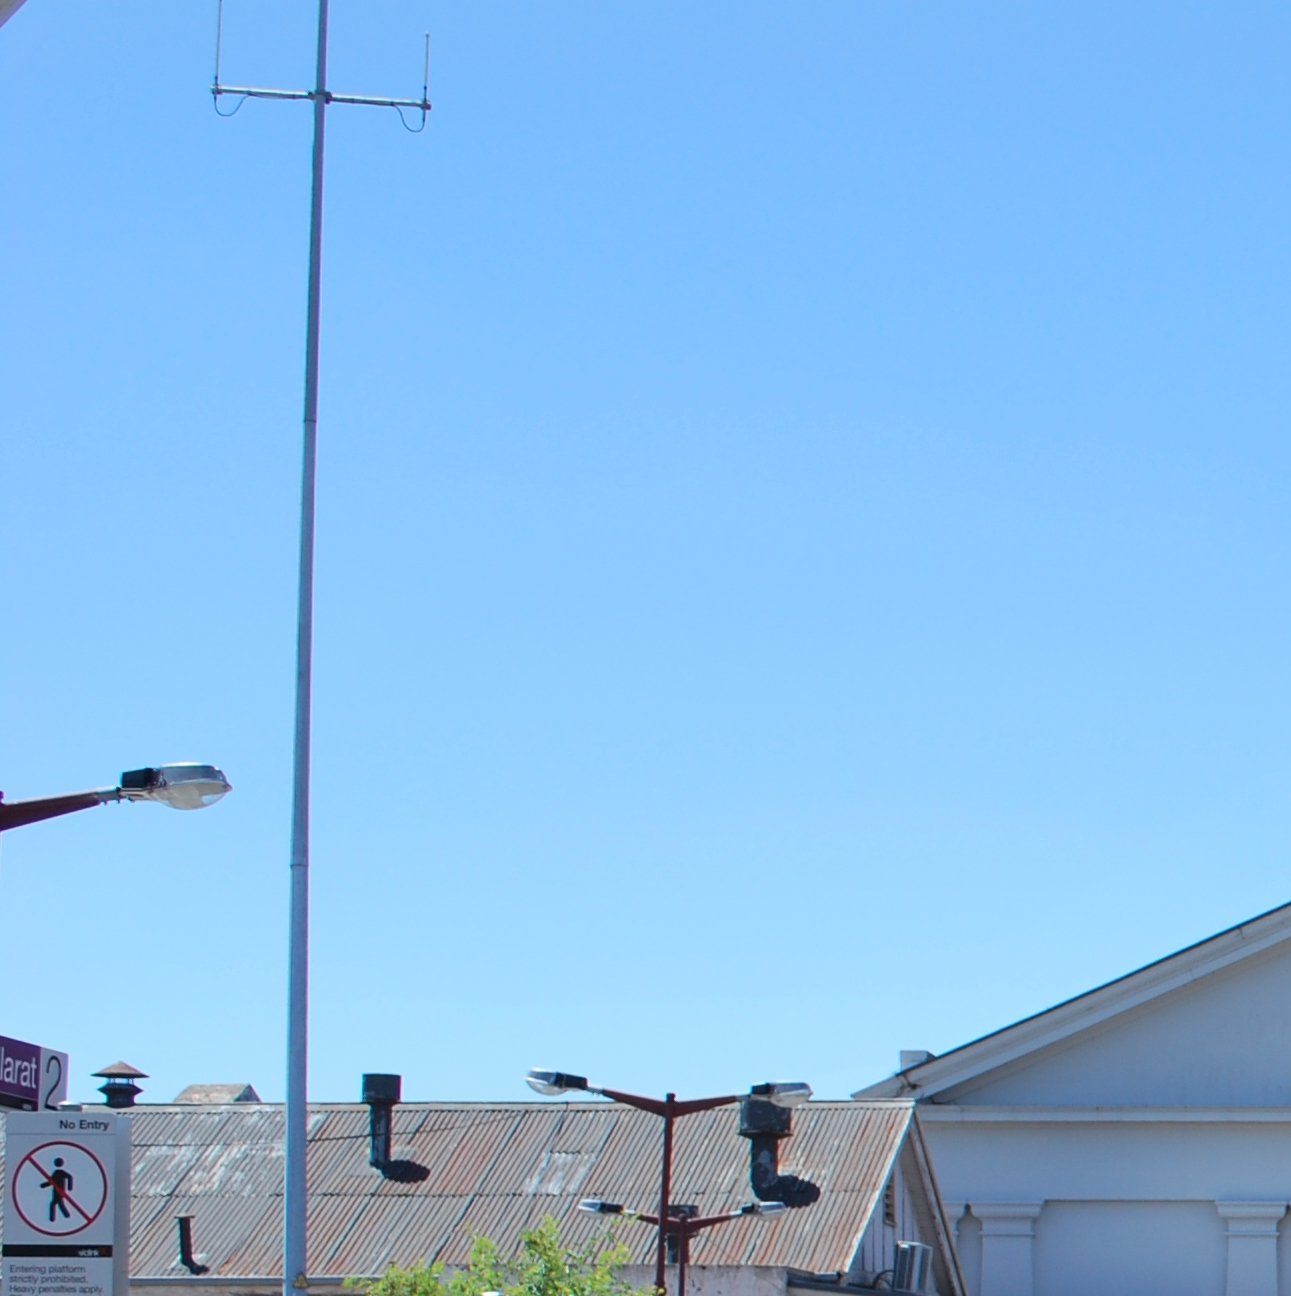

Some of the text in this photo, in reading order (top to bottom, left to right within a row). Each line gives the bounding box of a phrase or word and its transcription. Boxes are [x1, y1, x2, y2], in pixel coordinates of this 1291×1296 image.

[44, 1055, 63, 1112] 2
[59, 1119, 110, 1132] No Entry
[9, 1264, 86, 1275] Entering platform
[9, 1275, 88, 1285] strictly prohibited.
[9, 1285, 104, 1295] Heavy penalties apply.
